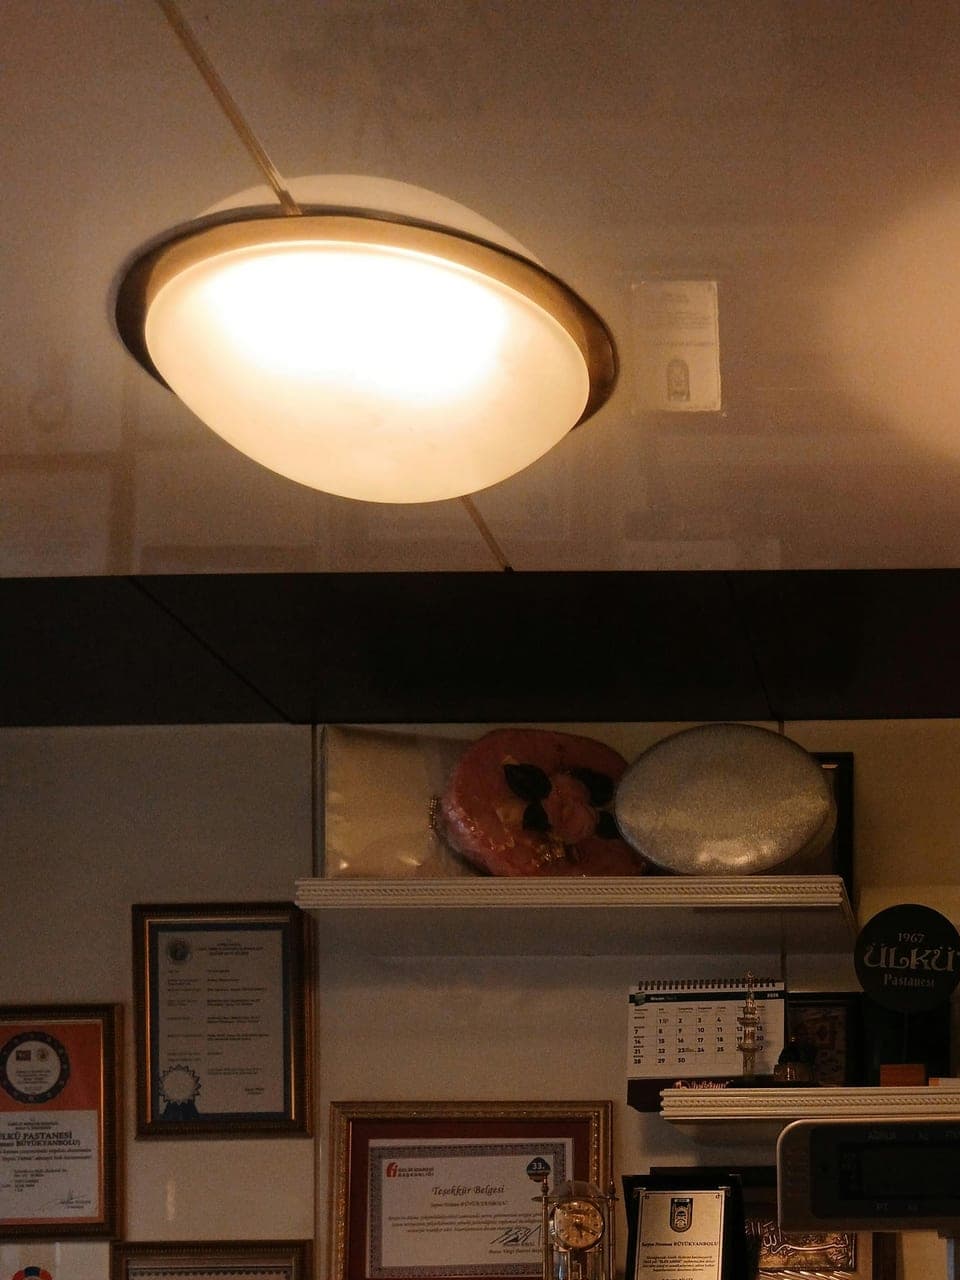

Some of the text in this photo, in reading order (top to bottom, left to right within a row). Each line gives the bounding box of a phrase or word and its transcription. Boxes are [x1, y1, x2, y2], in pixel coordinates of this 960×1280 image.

[897, 932, 925, 944] 1967
[23, 1130, 72, 1140] PASTANESİ
[433, 1183, 505, 1197] Teşekkür Belgesi
